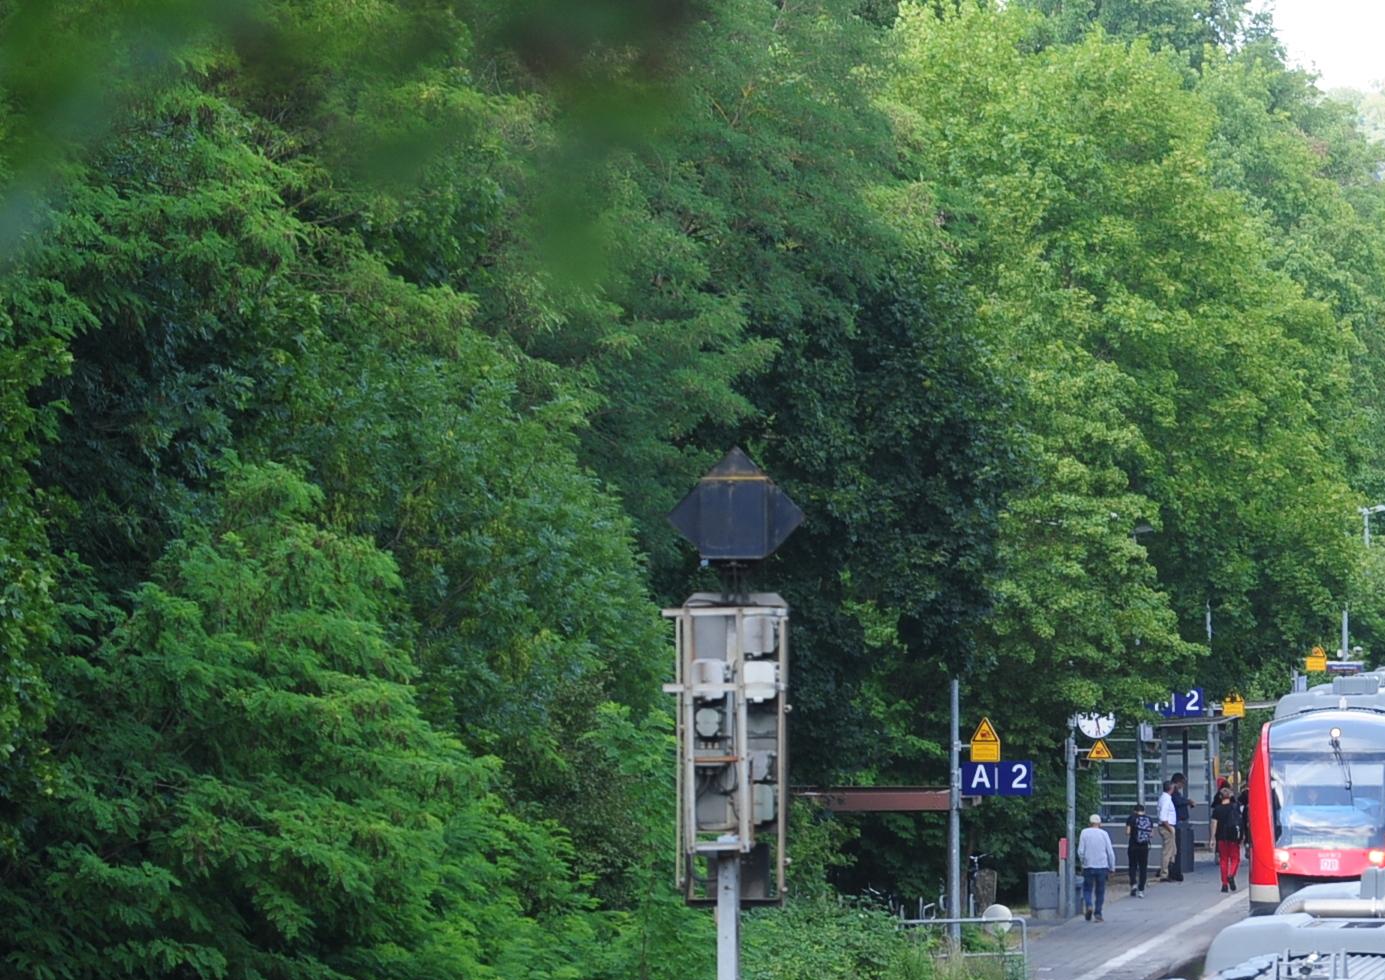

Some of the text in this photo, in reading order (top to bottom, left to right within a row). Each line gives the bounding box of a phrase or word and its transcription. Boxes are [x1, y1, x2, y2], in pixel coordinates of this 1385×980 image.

[1185, 690, 1200, 711] 2
[971, 763, 1028, 789] A 2
